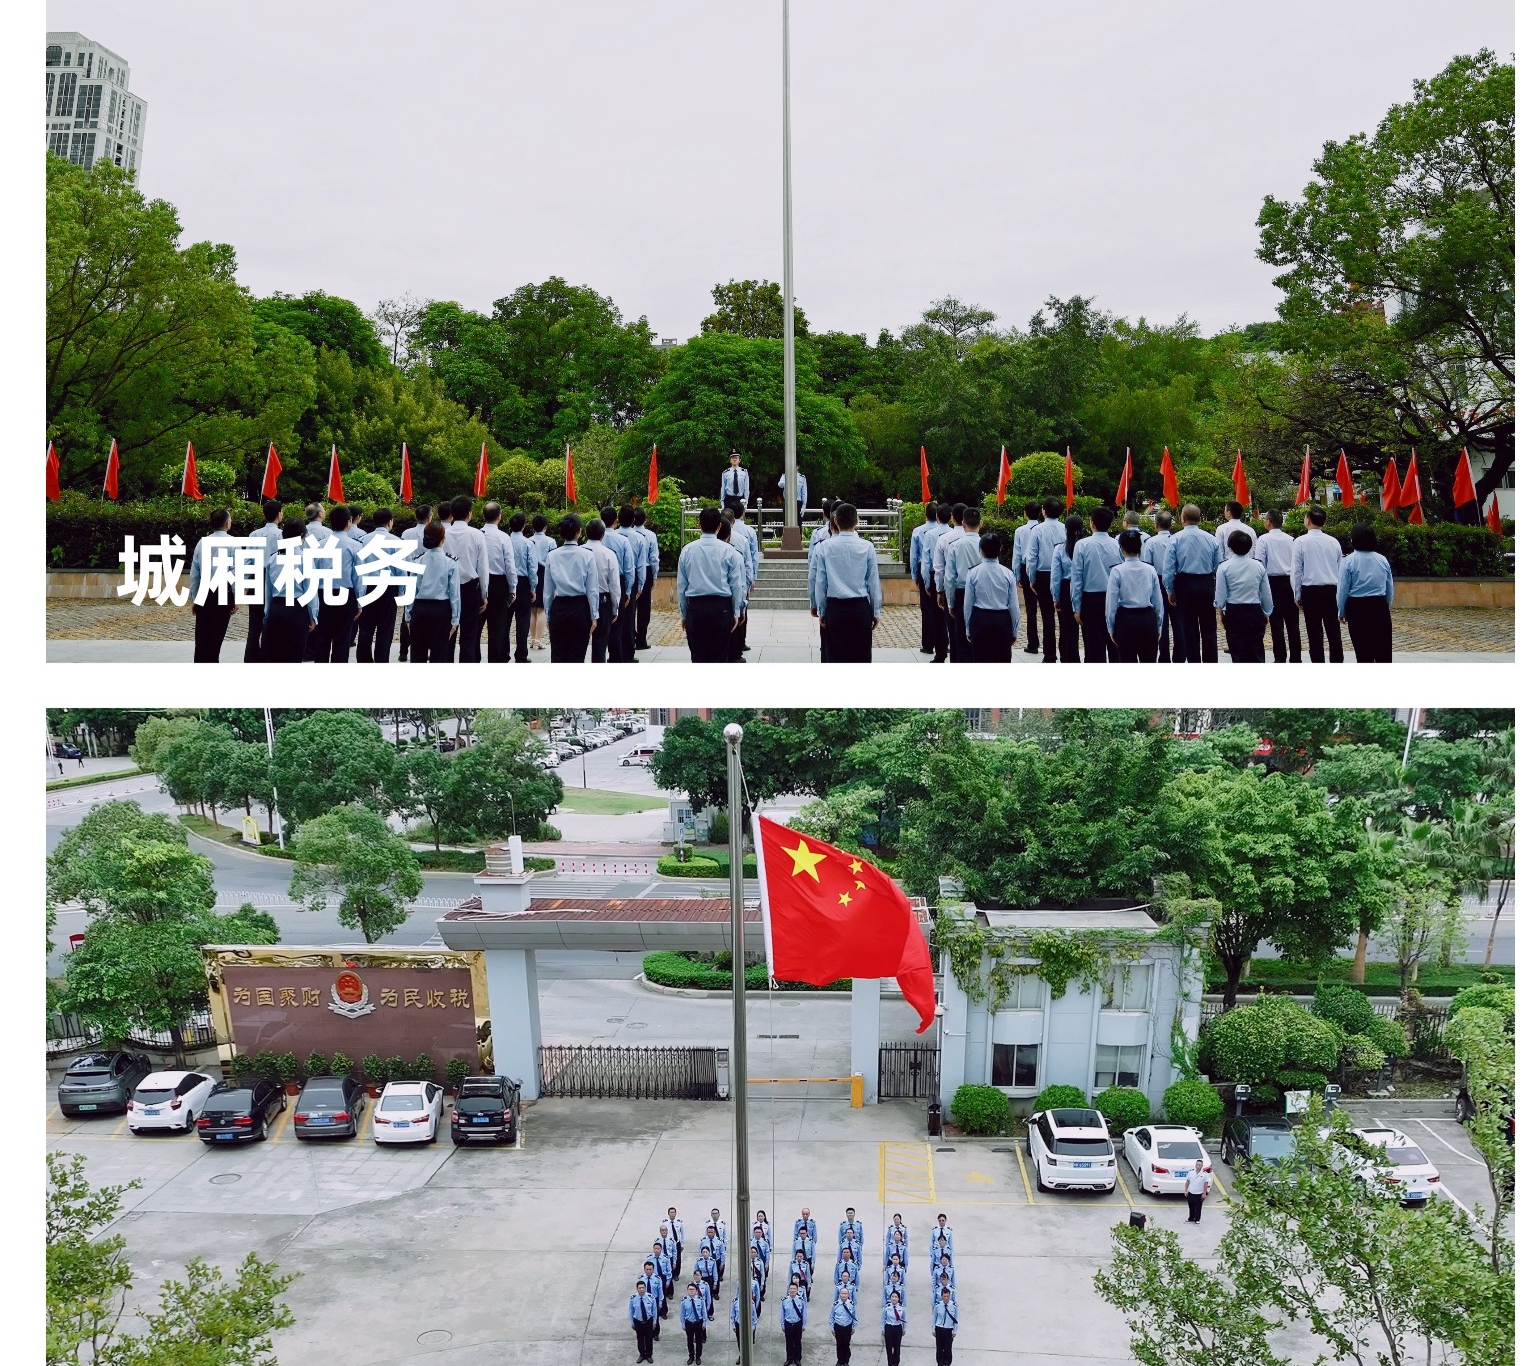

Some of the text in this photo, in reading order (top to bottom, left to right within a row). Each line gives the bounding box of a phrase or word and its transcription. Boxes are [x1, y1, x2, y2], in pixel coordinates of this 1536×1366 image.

[233, 987, 471, 1009] 为国聚财 为民收税
